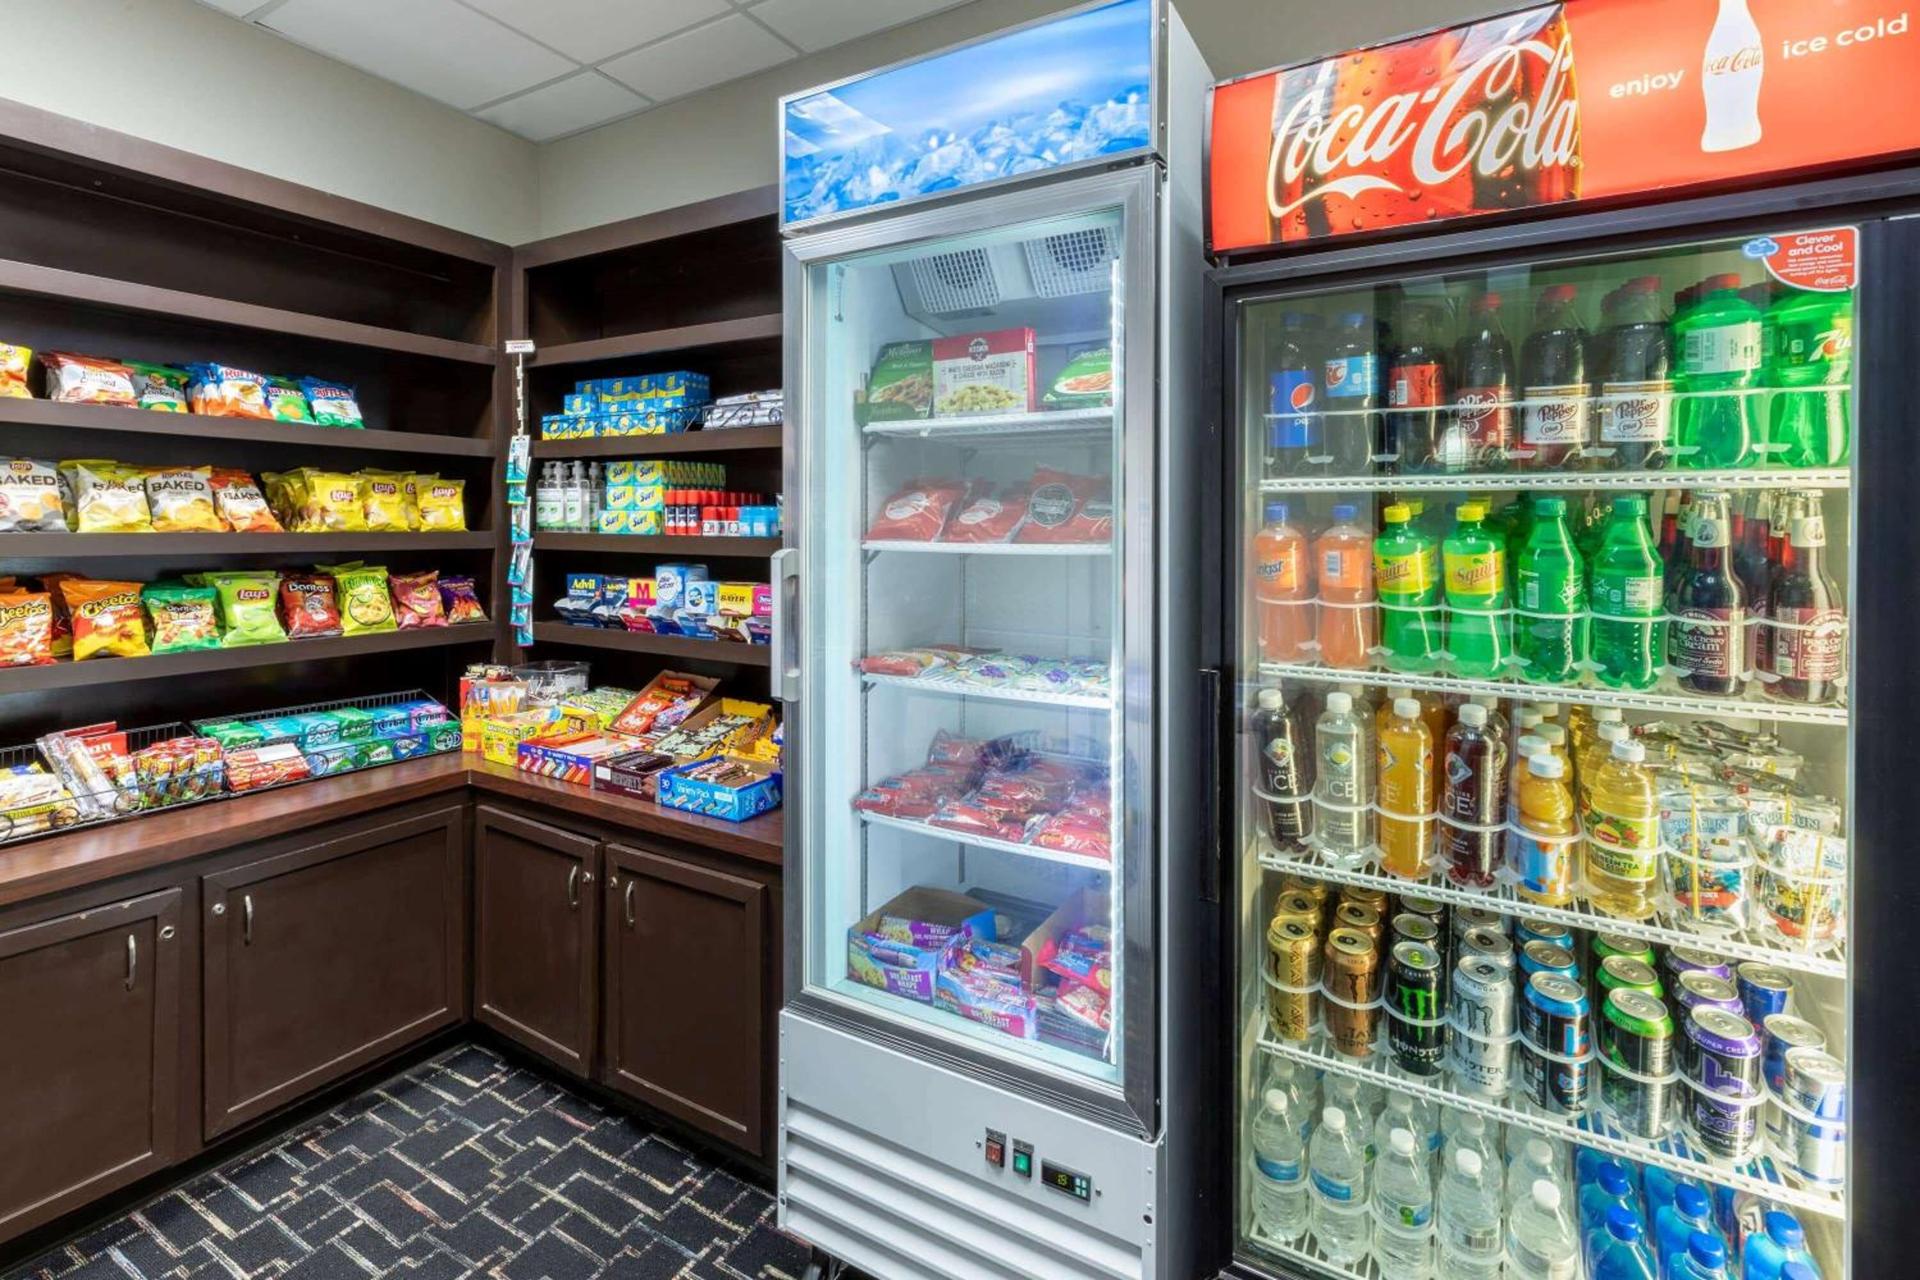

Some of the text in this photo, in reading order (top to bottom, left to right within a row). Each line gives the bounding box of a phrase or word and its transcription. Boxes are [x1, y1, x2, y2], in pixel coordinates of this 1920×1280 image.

[1783, 13, 1908, 60] ice cold
[1609, 69, 1685, 99] enjoy
[1266, 33, 1580, 218] Coca-Cola
[1795, 234, 1836, 246] Clever
[1788, 241, 1844, 257] and Cool
[151, 481, 205, 492] BAKED
[288, 582, 330, 594] Doritos
[573, 579, 596, 590] Advil
[1268, 773, 1298, 791] ICE
[1326, 779, 1357, 798] ICE
